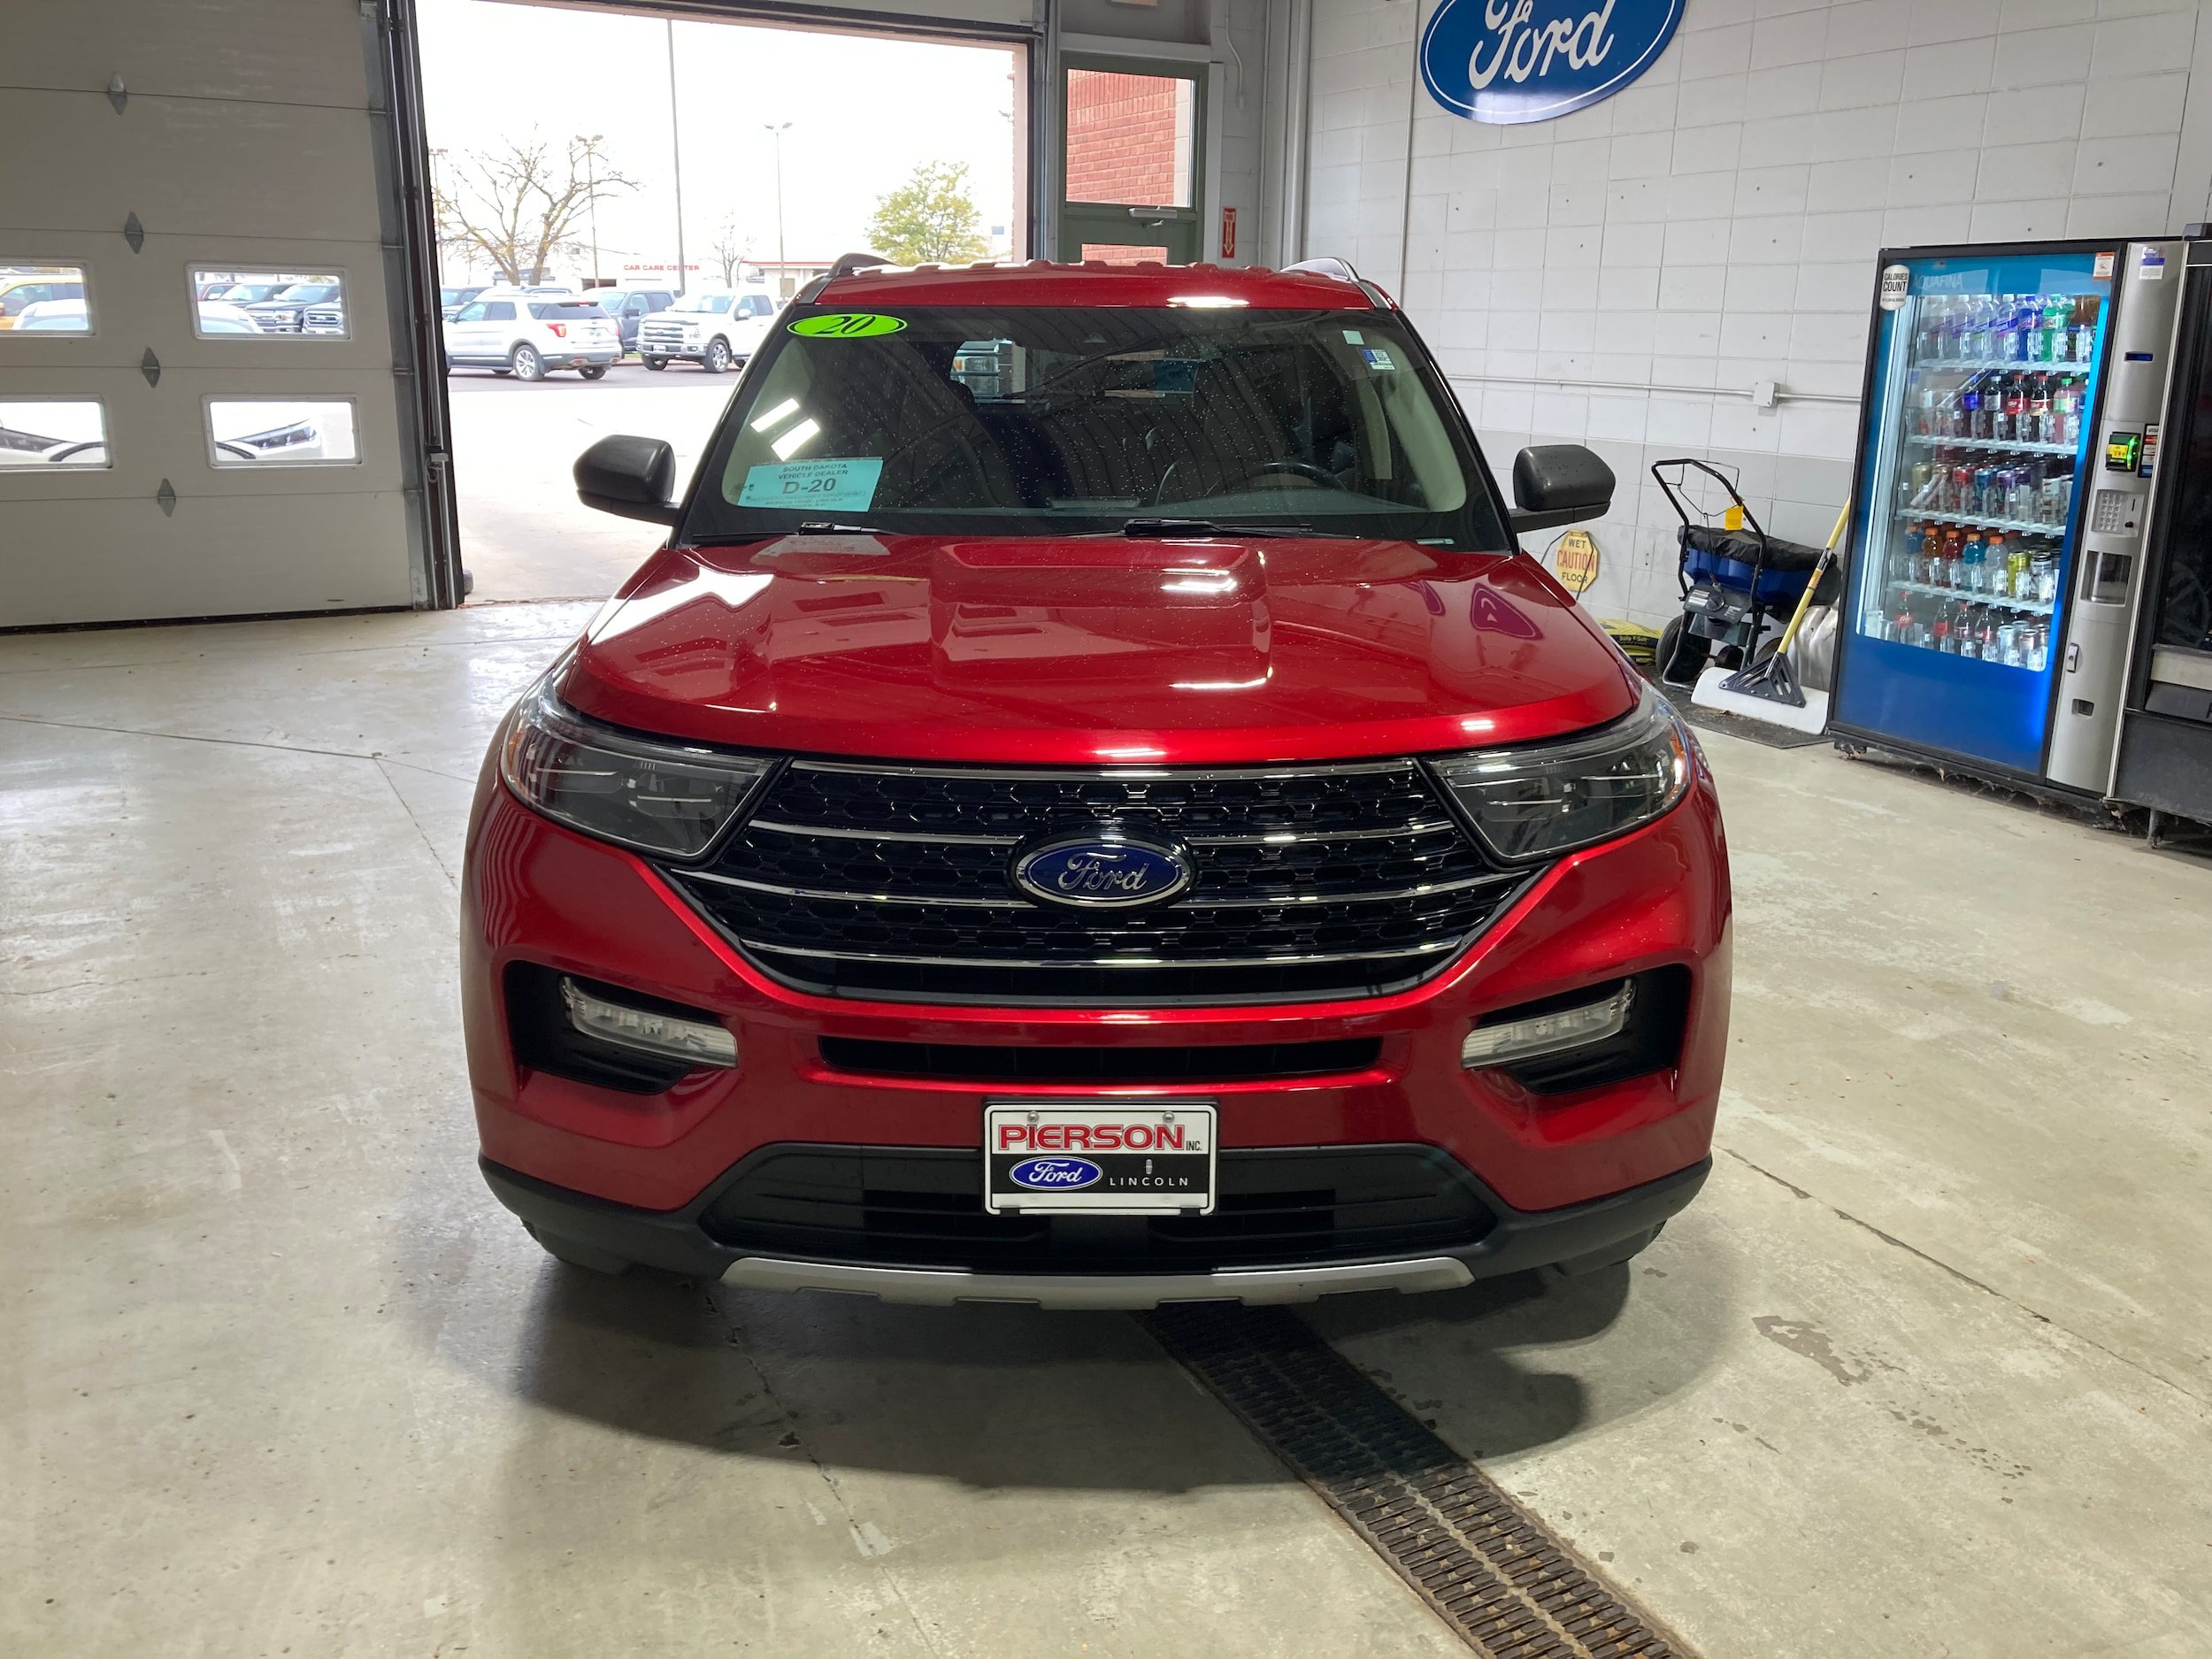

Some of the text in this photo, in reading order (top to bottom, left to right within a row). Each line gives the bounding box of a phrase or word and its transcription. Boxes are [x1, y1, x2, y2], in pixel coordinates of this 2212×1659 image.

[1469, 0, 1616, 89] Ford
[1883, 280, 1908, 292] COUNT
[813, 316, 877, 334] 20
[782, 478, 836, 495] D-20
[1568, 538, 1586, 549] WET
[1557, 549, 1595, 572] CAUTION
[1562, 572, 1588, 584] FLOOR
[1057, 852, 1150, 890] Ford
[998, 1124, 1203, 1151] PIERSON INC.
[1028, 1157, 1188, 1186] Ford LINCOLN
